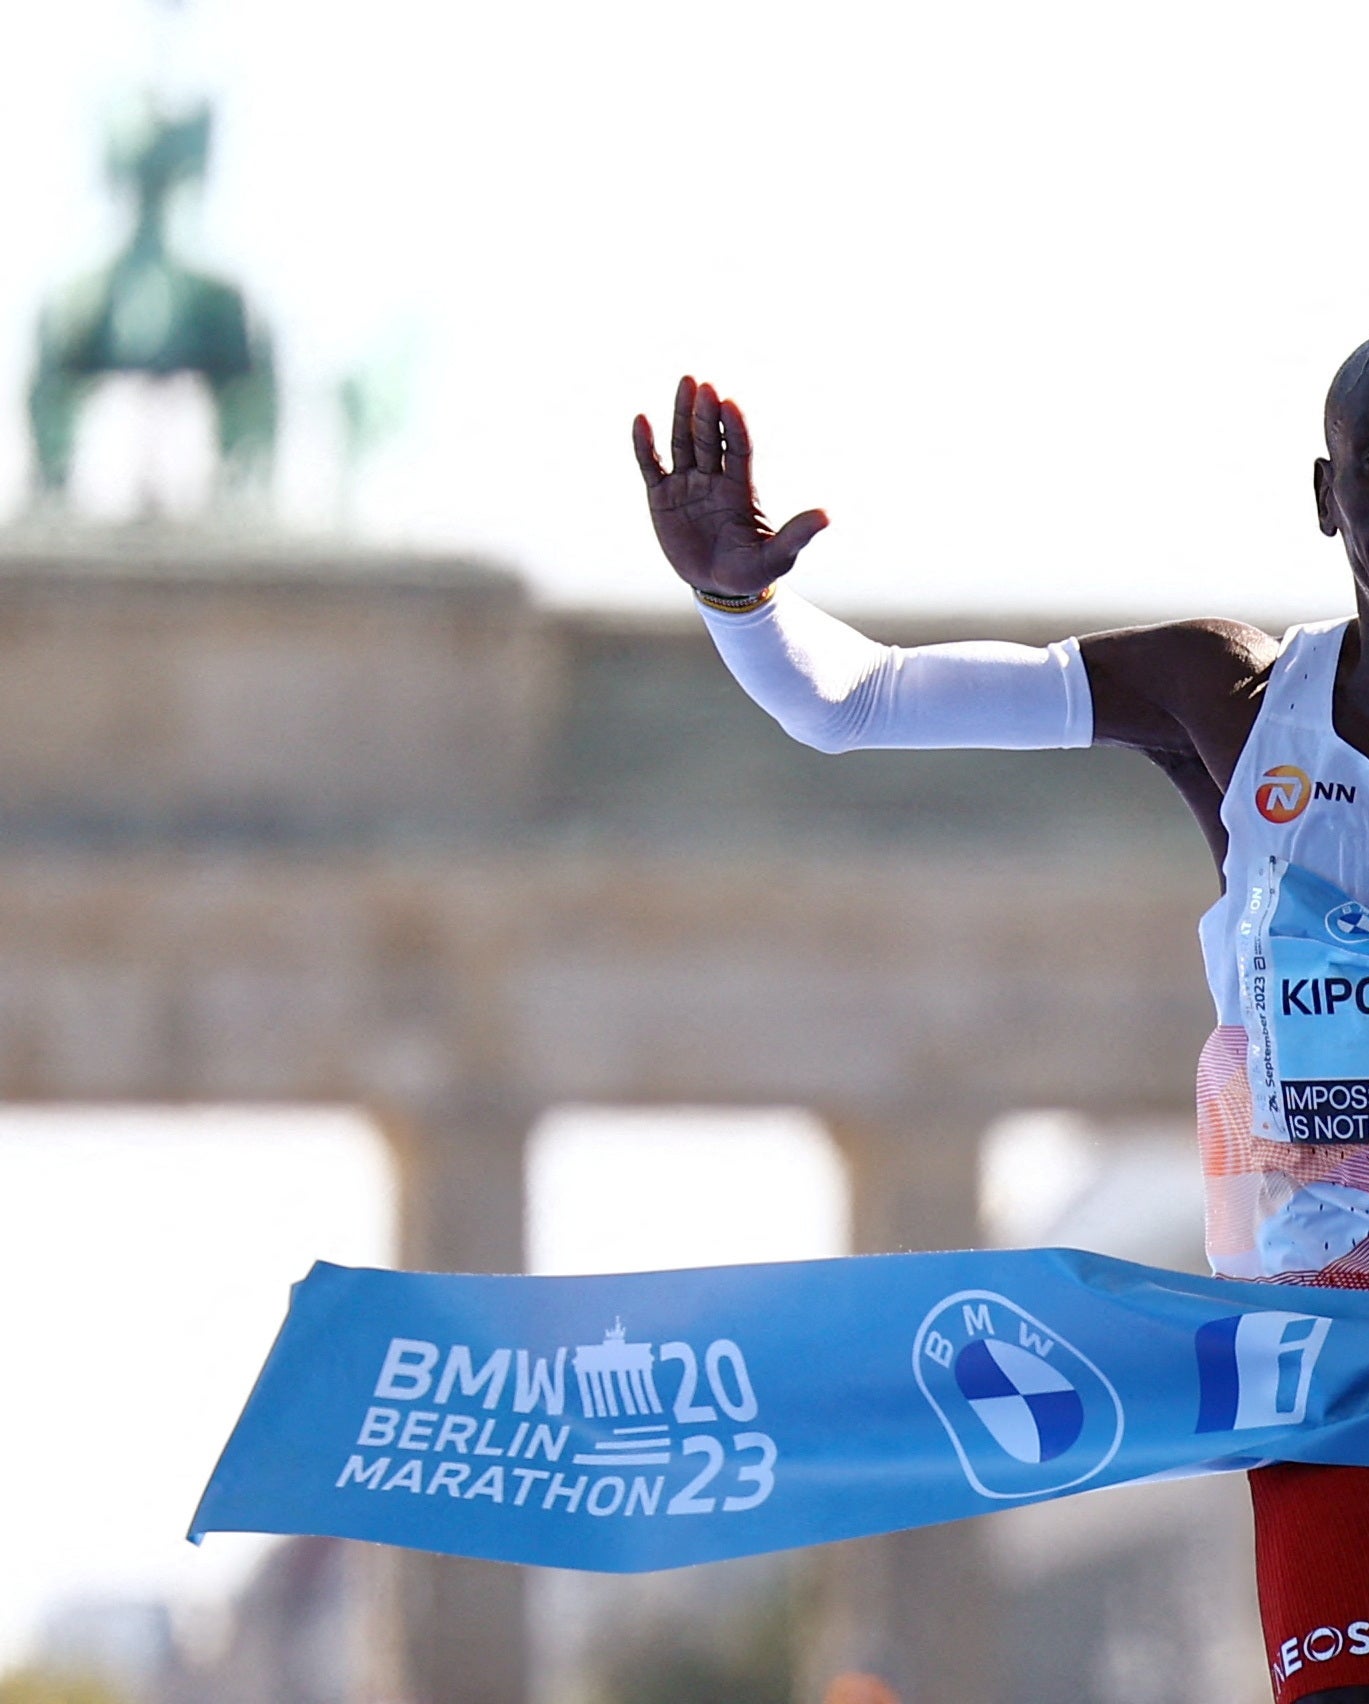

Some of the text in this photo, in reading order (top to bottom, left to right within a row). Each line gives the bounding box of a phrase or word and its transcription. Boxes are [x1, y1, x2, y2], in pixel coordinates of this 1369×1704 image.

[1314, 781, 1356, 804] NN
[1254, 975, 1266, 1011] 2023
[1260, 1013, 1276, 1088] September
[1290, 1115, 1309, 1139] IS
[925, 1303, 1054, 1369] BMW
[373, 1337, 759, 1424] BMW 20
[356, 1406, 570, 1462] BERLIN
[335, 1431, 778, 1517] MARATHON 23
